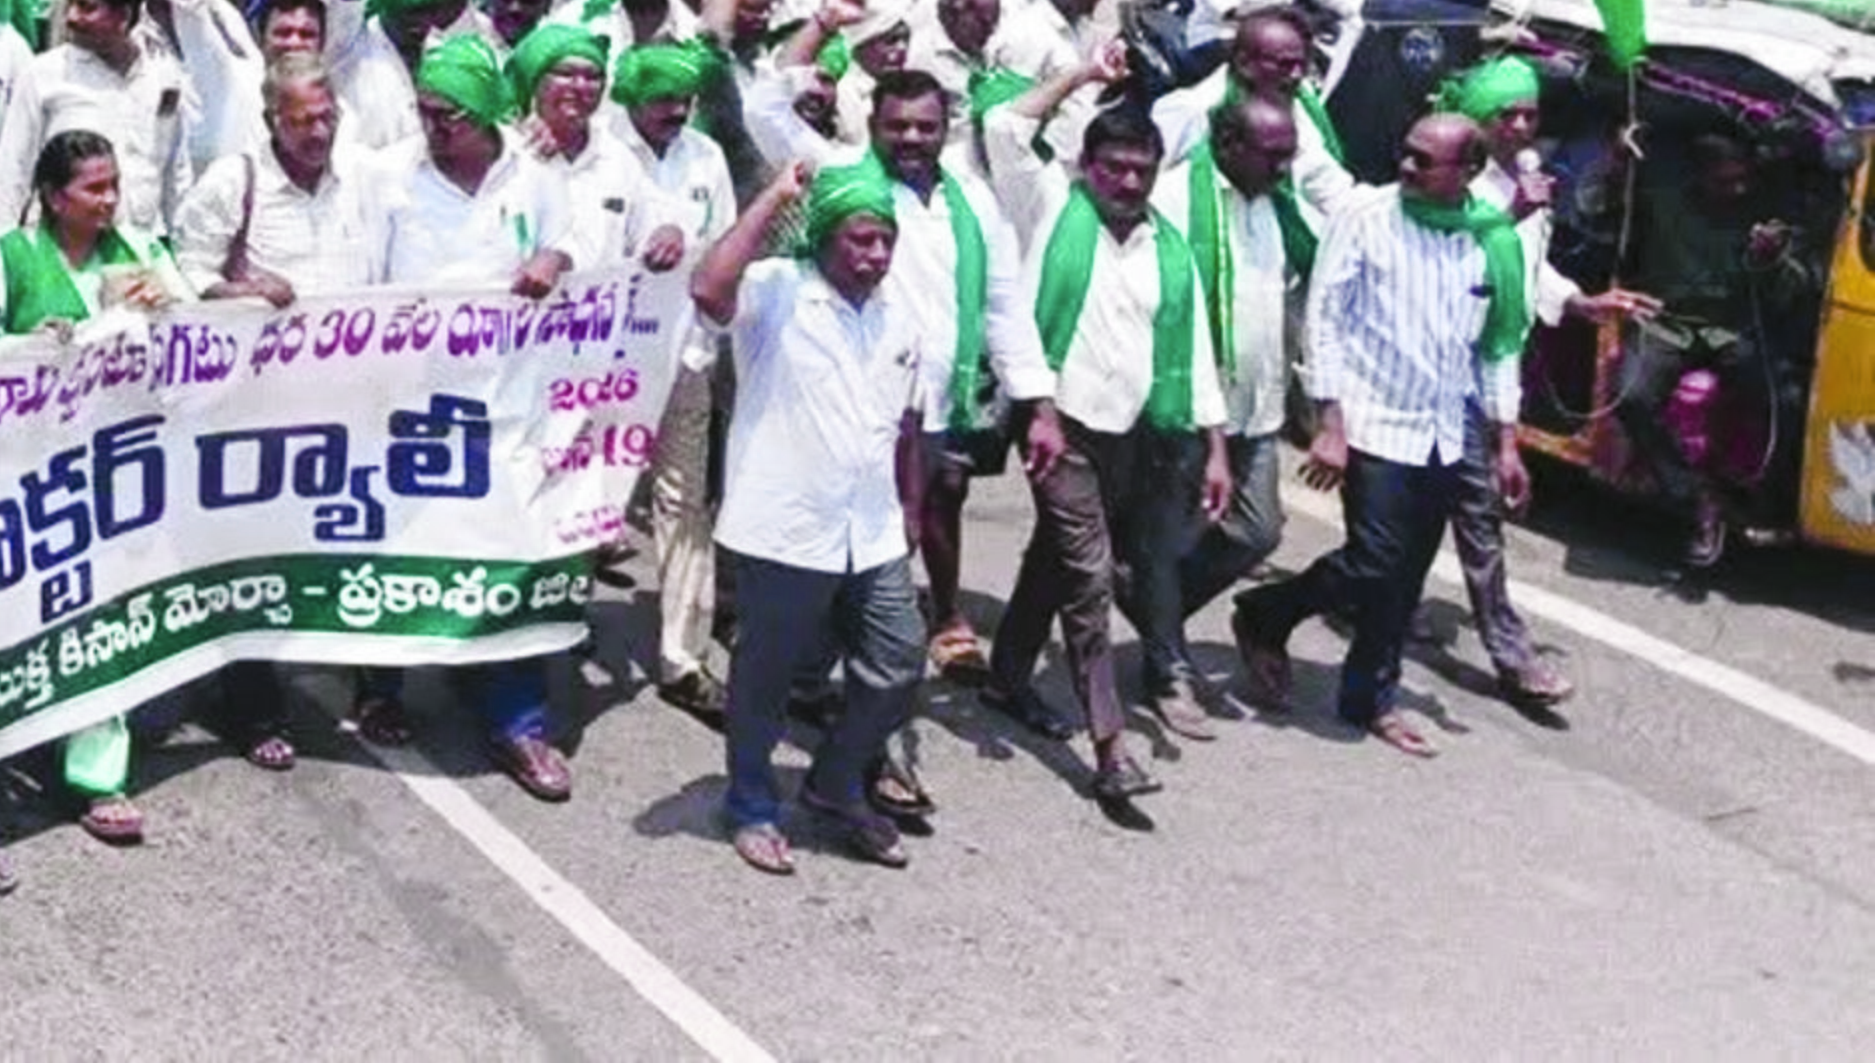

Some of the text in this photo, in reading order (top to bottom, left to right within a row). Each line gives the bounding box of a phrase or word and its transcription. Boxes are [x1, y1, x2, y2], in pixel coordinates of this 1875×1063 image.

[313, 307, 376, 359] 30
[194, 393, 493, 543] ర్యాలీ
[603, 423, 655, 467] 19
[58, 592, 156, 675] కిసాన్
[162, 574, 293, 630] మోర్చా
[337, 562, 521, 627] ప్రకాశం
